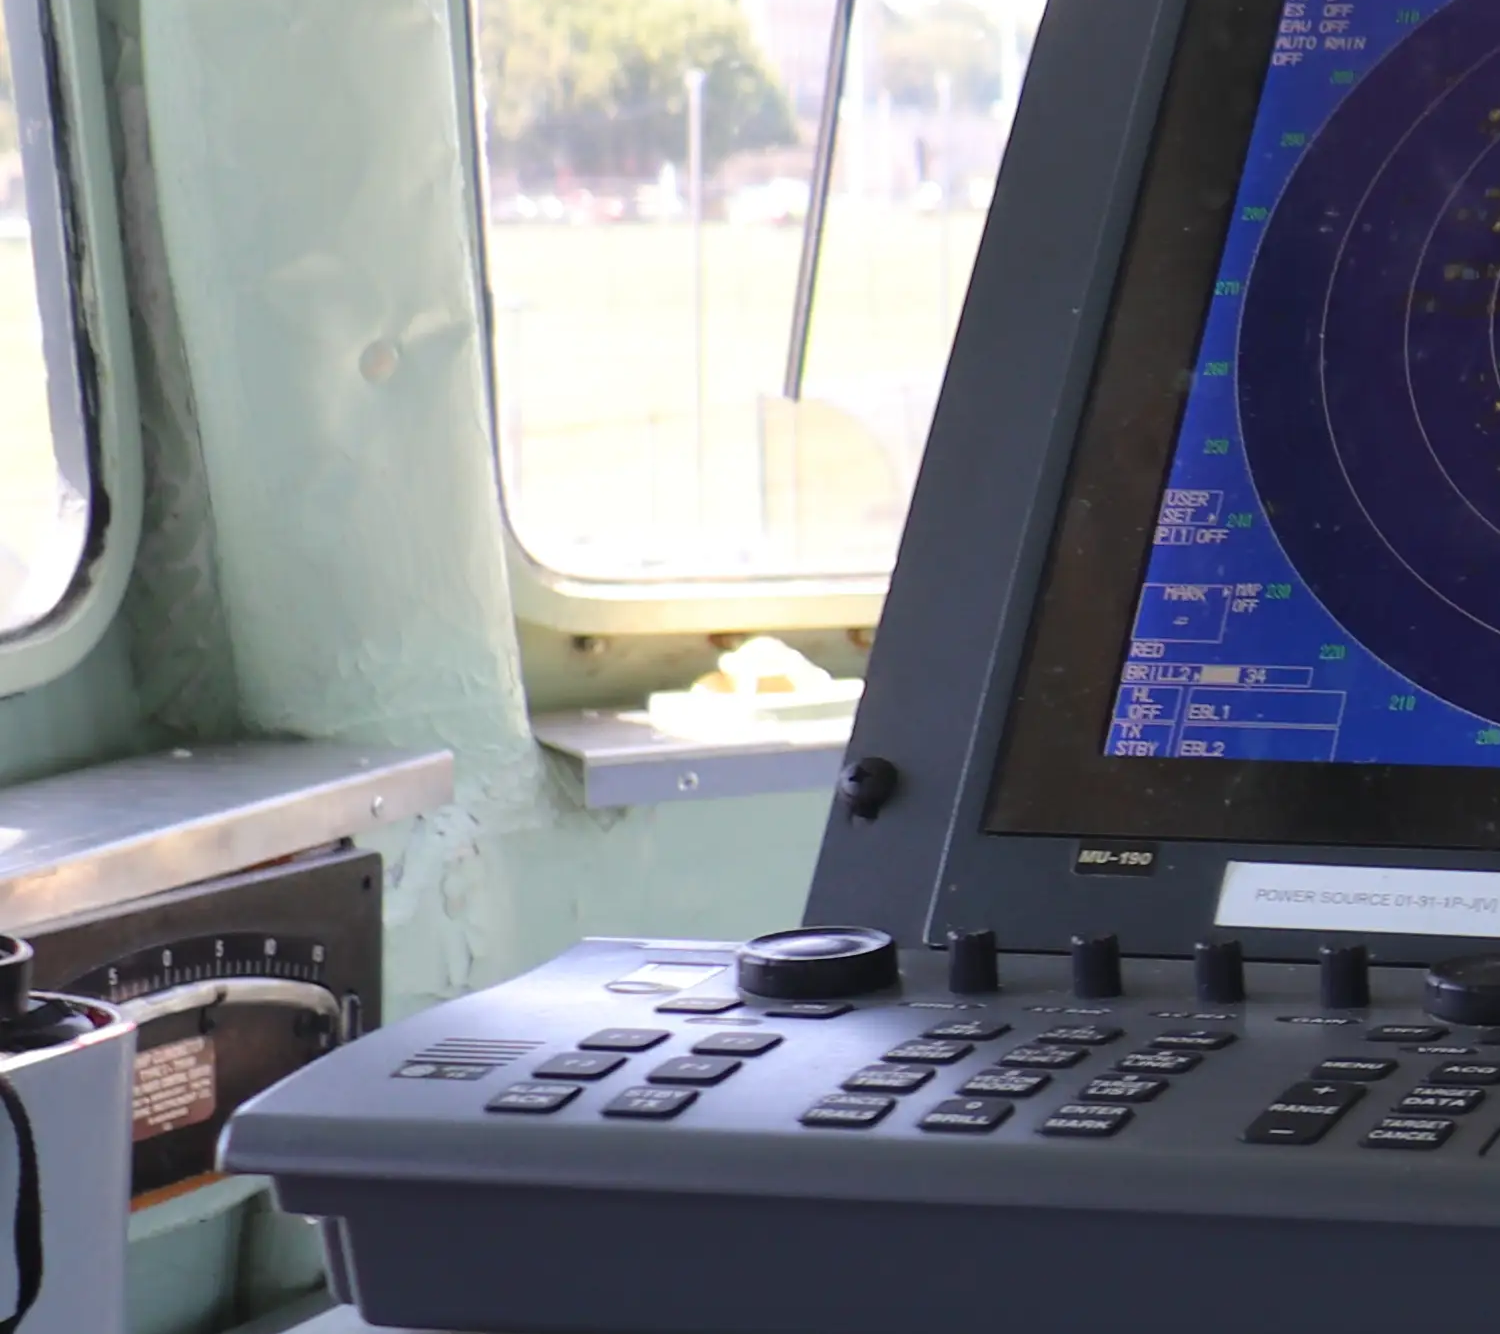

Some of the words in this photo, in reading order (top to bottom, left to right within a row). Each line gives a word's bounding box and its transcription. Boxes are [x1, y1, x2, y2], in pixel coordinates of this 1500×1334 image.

[1323, 3, 1355, 17] OFF
[1319, 20, 1351, 33] OFF
[1275, 36, 1317, 50] AUTO
[1324, 36, 1367, 50] RAIN
[1271, 52, 1304, 66] OFF
[1168, 491, 1210, 507] USER
[1163, 508, 1196, 524] SET
[1196, 529, 1229, 544] OFF
[1232, 598, 1260, 613] OFF
[1131, 643, 1165, 658] RED
[1244, 669, 1267, 683] 34
[1131, 687, 1153, 703] HL
[1127, 704, 1164, 719] OFF
[1188, 705, 1231, 719] EBL1
[1120, 724, 1143, 739] TX
[1115, 742, 1158, 757] STBY
[1181, 742, 1226, 757] EBL2
[1078, 849, 1154, 866] MU-190
[1255, 888, 1316, 904] POWER
[1319, 890, 1392, 907] SOURCE
[215, 940, 224, 957] 5
[264, 938, 277, 956] 10
[162, 949, 172, 966] 0
[108, 969, 118, 985] 5
[1321, 1061, 1387, 1070] MENU
[1412, 1087, 1482, 1097] TARGET
[1268, 1103, 1341, 1115] RANGE
[1402, 1097, 1467, 1107] DATA
[1060, 1105, 1128, 1115] ENTER
[1045, 1119, 1112, 1129] MARK
[1381, 1118, 1453, 1129] TARGET
[1368, 1129, 1438, 1142] CANCEL
